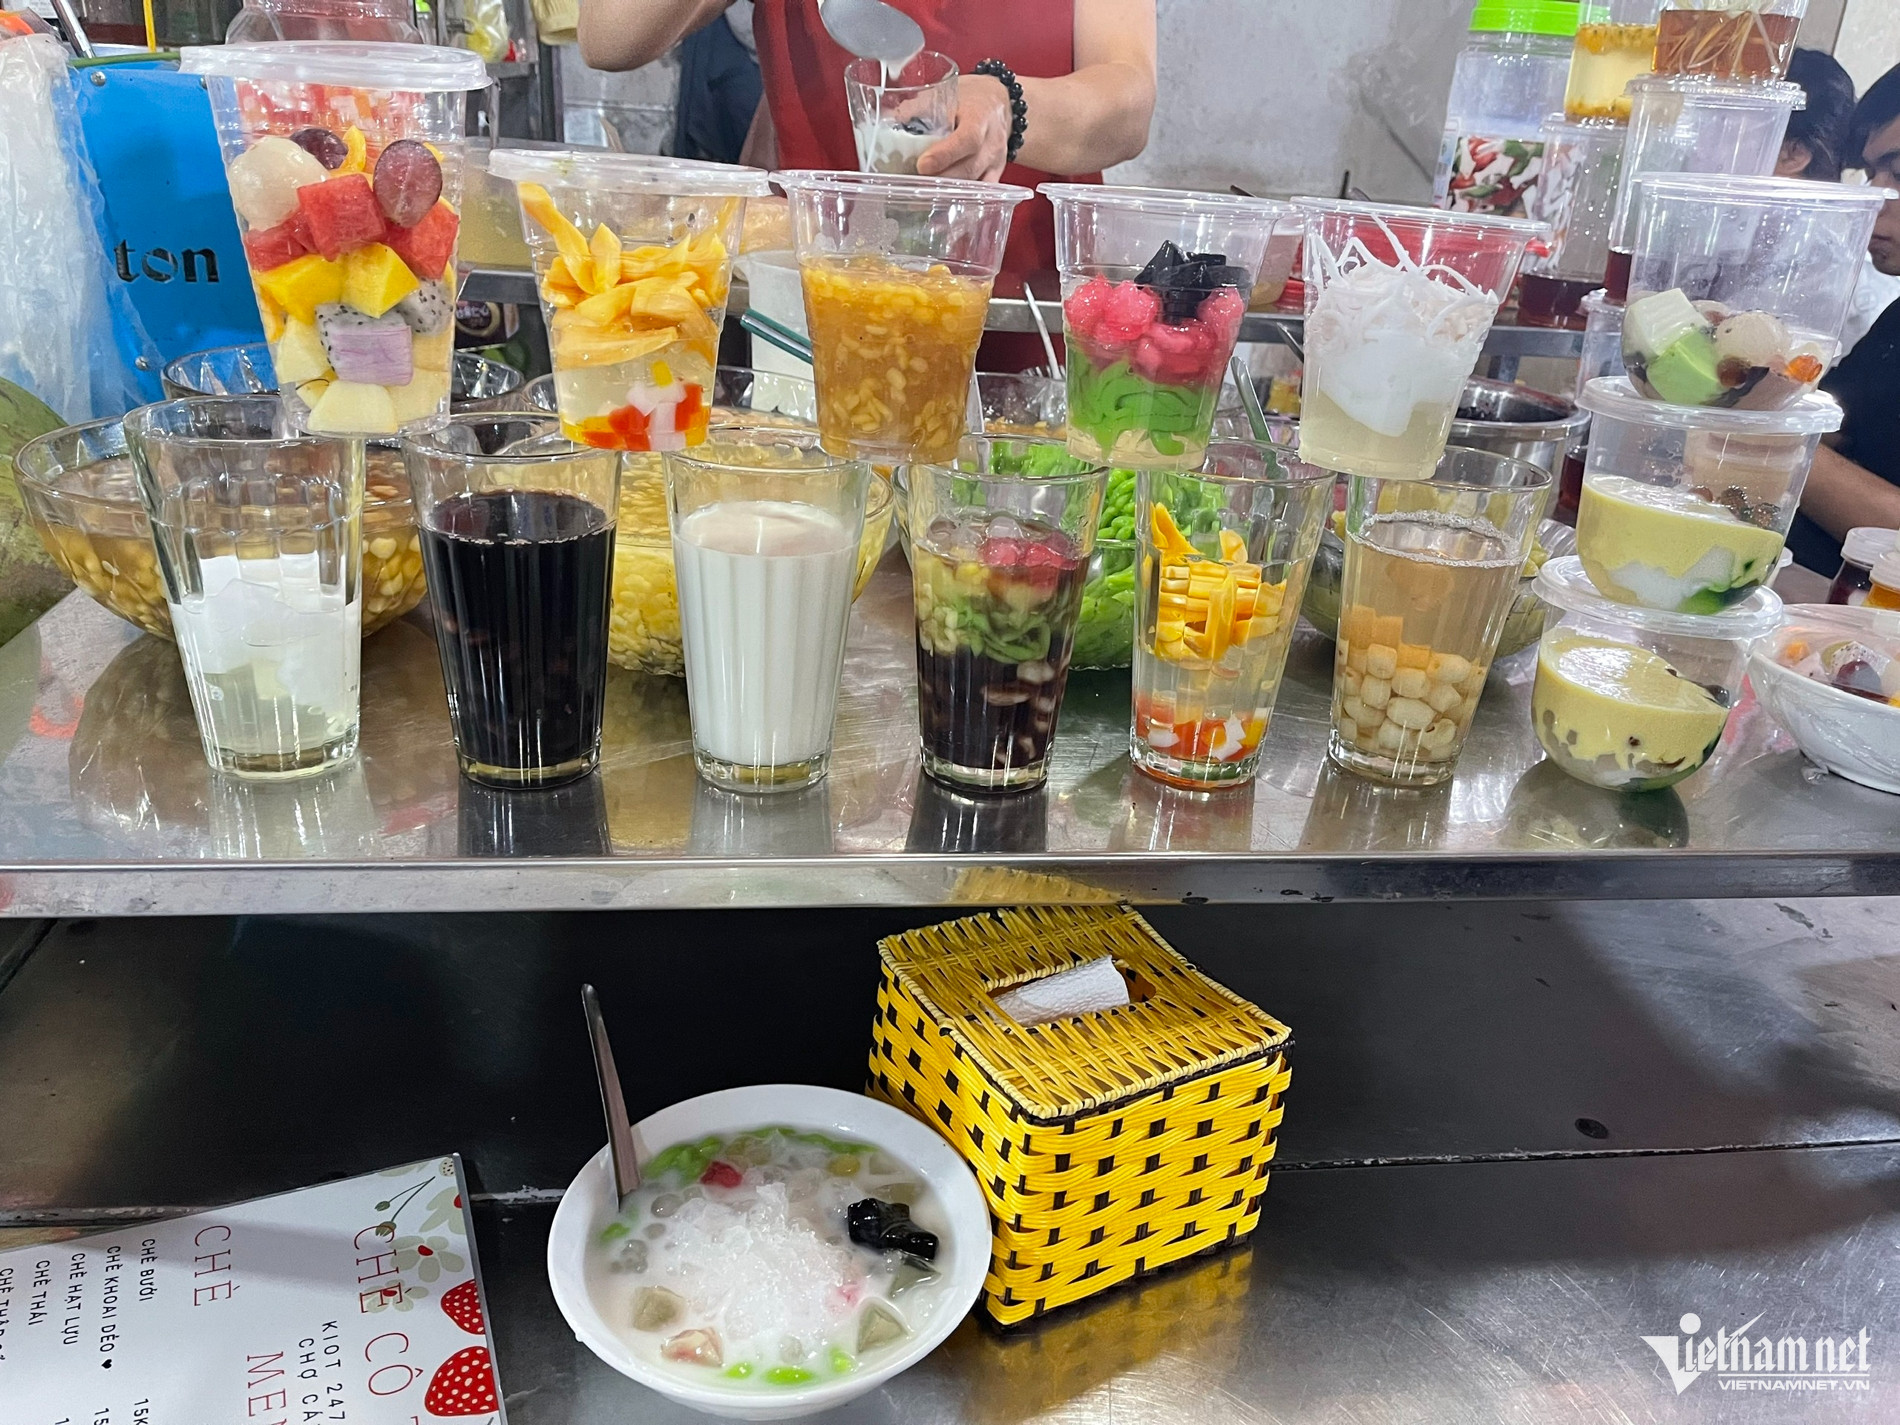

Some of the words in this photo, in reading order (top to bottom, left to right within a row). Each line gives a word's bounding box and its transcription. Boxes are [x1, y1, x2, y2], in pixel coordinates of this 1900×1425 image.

[69, 1253, 87, 1279] CHÈ
[105, 1246, 123, 1272] CHÈ
[140, 1238, 158, 1264] CHÈ
[194, 1225, 240, 1306] CHÈ
[33, 1260, 52, 1287] CHÈ
[139, 1269, 157, 1301] BƯỞI
[354, 1225, 412, 1313] CHÈ
[28, 1291, 48, 1325] THÁI
[64, 1284, 83, 1310] HẠT
[102, 1276, 119, 1319] KHOAI
[61, 1316, 80, 1345] LỰU
[100, 1324, 119, 1352] DẺO
[322, 1320, 341, 1368] KIOT
[297, 1338, 318, 1379] CHỢ
[365, 1333, 424, 1396] CÔ
[302, 1394, 323, 1425] CÁ
[326, 1383, 345, 1419] 247
